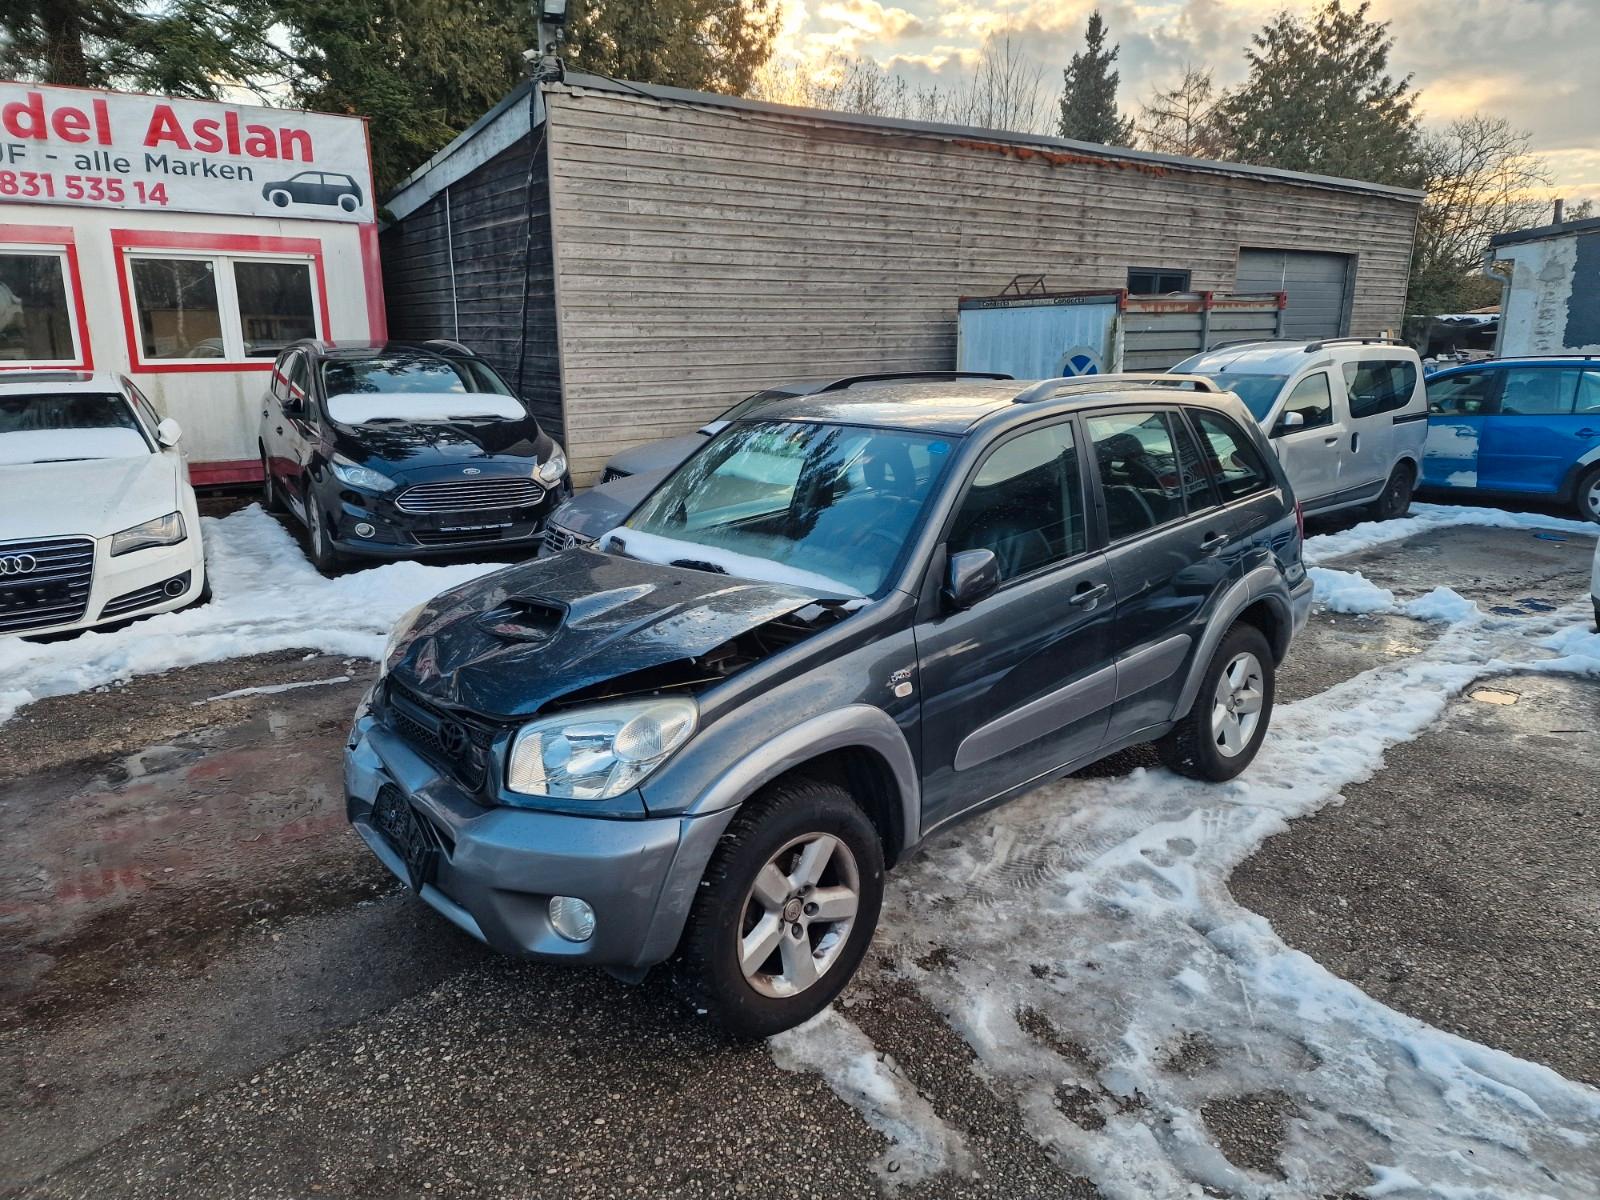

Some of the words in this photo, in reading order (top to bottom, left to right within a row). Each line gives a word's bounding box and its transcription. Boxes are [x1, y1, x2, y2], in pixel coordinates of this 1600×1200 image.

[2, 91, 113, 146] del
[143, 104, 314, 163] Aslan
[74, 150, 131, 174] alle
[144, 152, 254, 182] Marken
[0, 170, 55, 198] 831
[64, 174, 126, 204] 535
[132, 180, 169, 207] 14
